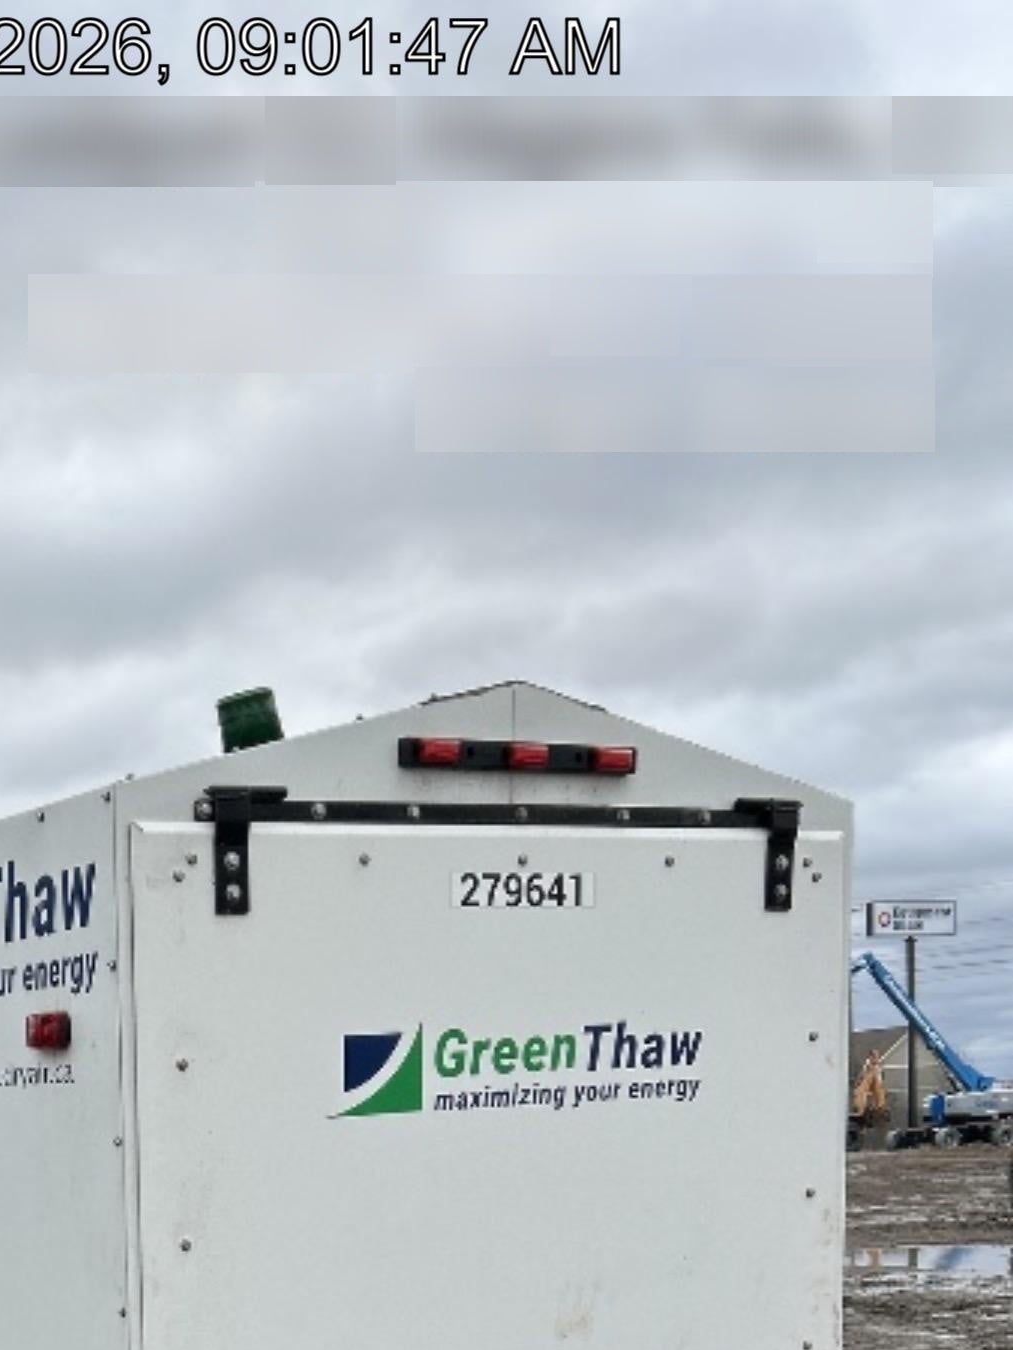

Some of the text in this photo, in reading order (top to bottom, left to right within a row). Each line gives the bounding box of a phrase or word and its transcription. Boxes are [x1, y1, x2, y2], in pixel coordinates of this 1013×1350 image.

[460, 872, 584, 908] 279641
[22, 951, 99, 994] energy
[433, 1020, 703, 1078] GreenThaw
[433, 1076, 702, 1113] maximizing your energy
